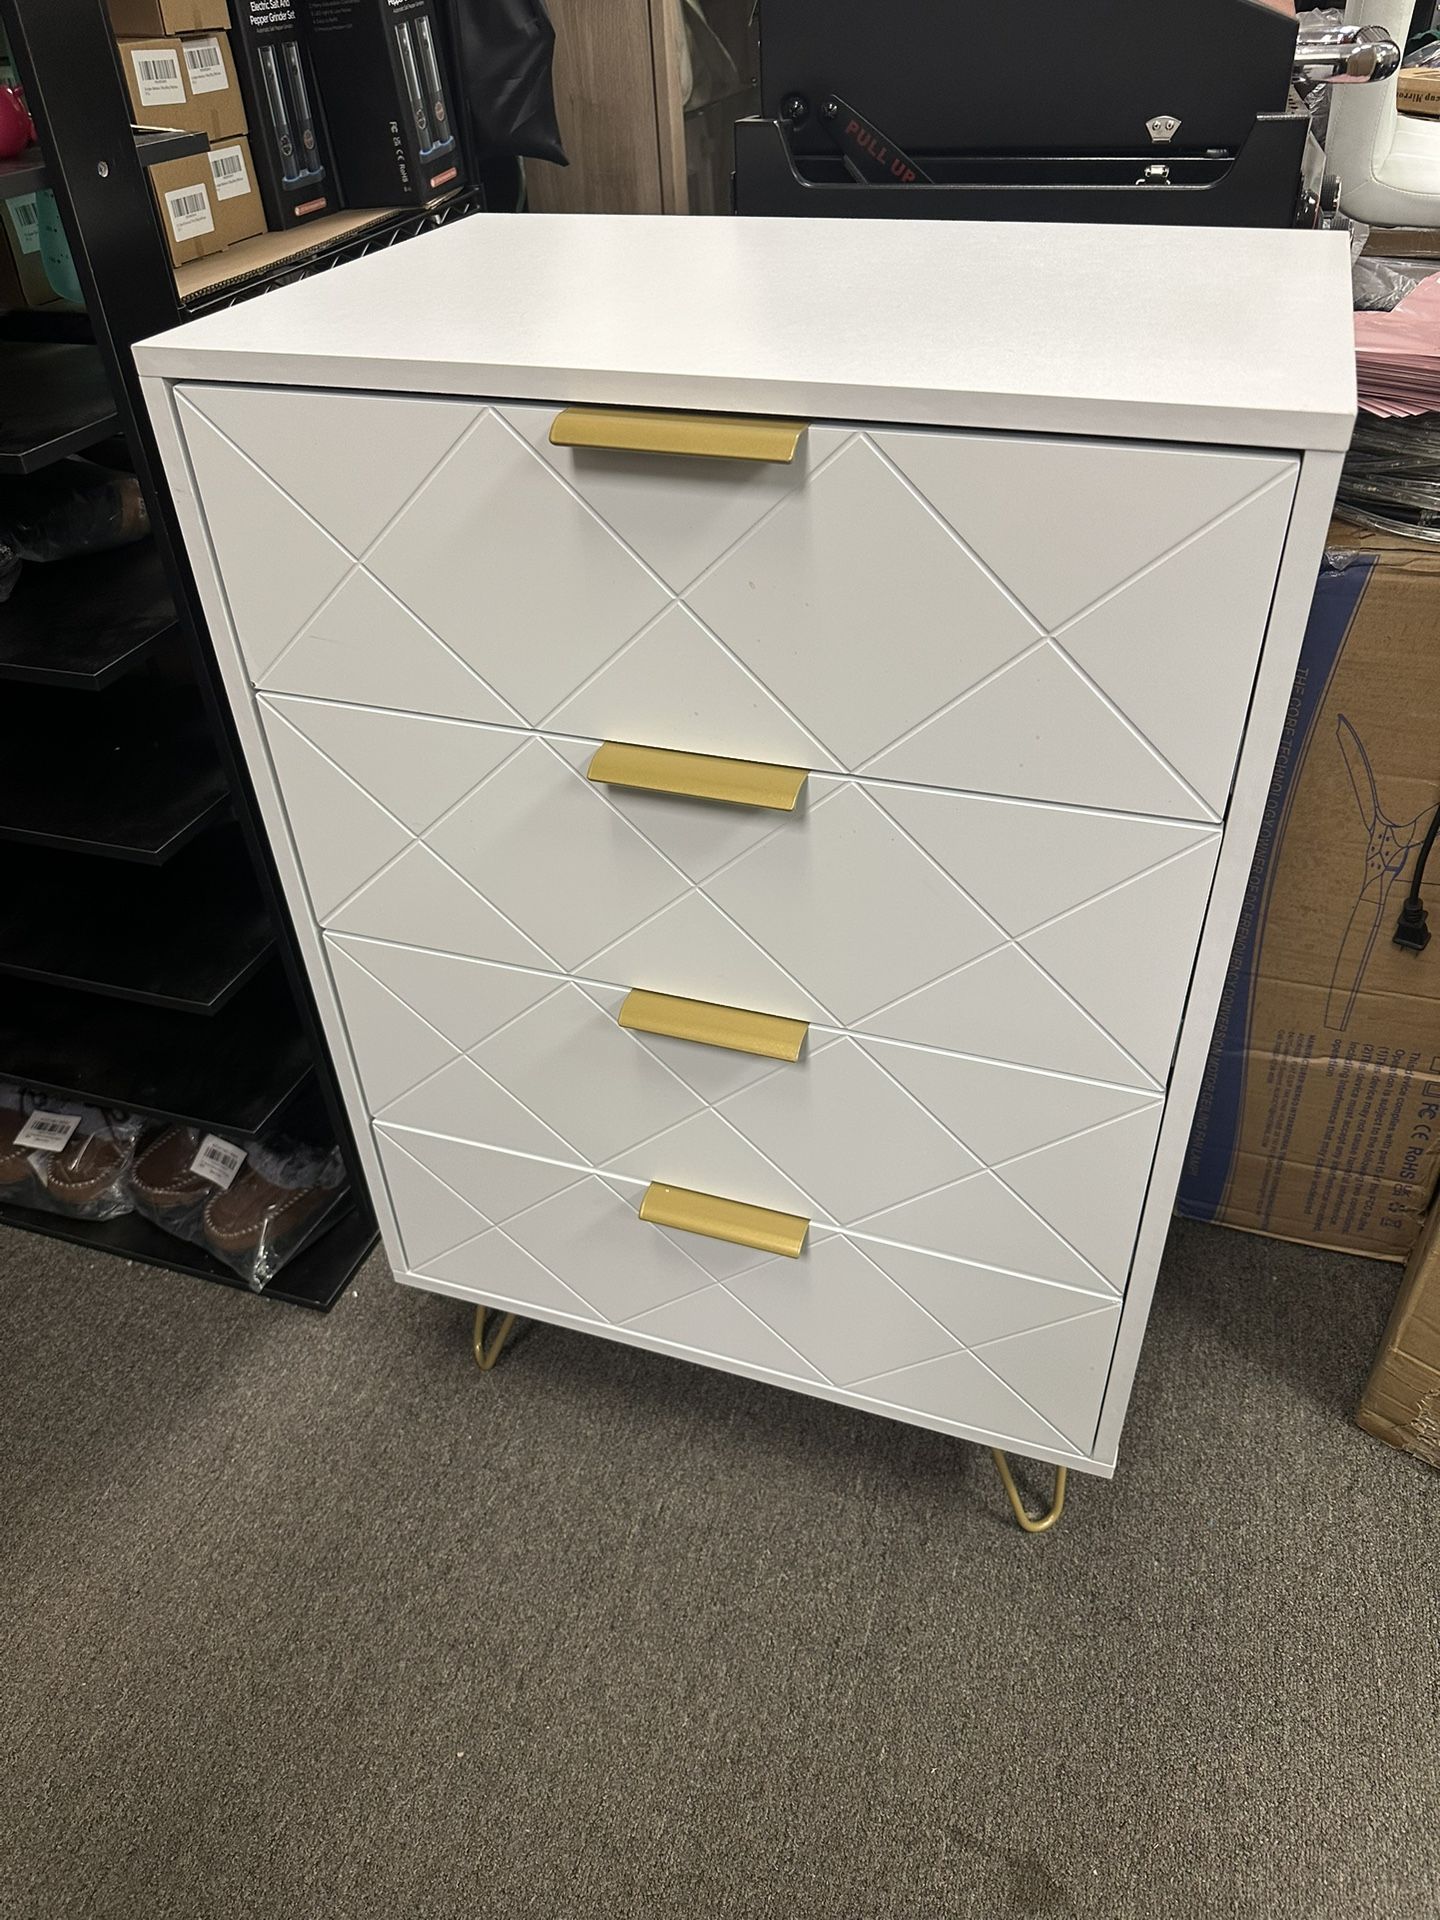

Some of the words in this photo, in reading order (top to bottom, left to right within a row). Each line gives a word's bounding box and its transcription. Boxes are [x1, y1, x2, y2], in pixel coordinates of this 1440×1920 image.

[249, 14, 269, 26] Pepper
[269, 11, 287, 22] Grinder
[287, 9, 296, 19] Set
[844, 119, 887, 165] PULL
[889, 158, 916, 182] UP
[1284, 697, 1302, 736] CORE
[1386, 1049, 1405, 1088] Operation
[1406, 1052, 1421, 1069] This
[1364, 1075, 1381, 1101] device
[1399, 1069, 1414, 1096] device
[1387, 1097, 1404, 1132] complies
[1399, 1146, 1425, 1179] RoHS
[1364, 1195, 1377, 1210] FCC
